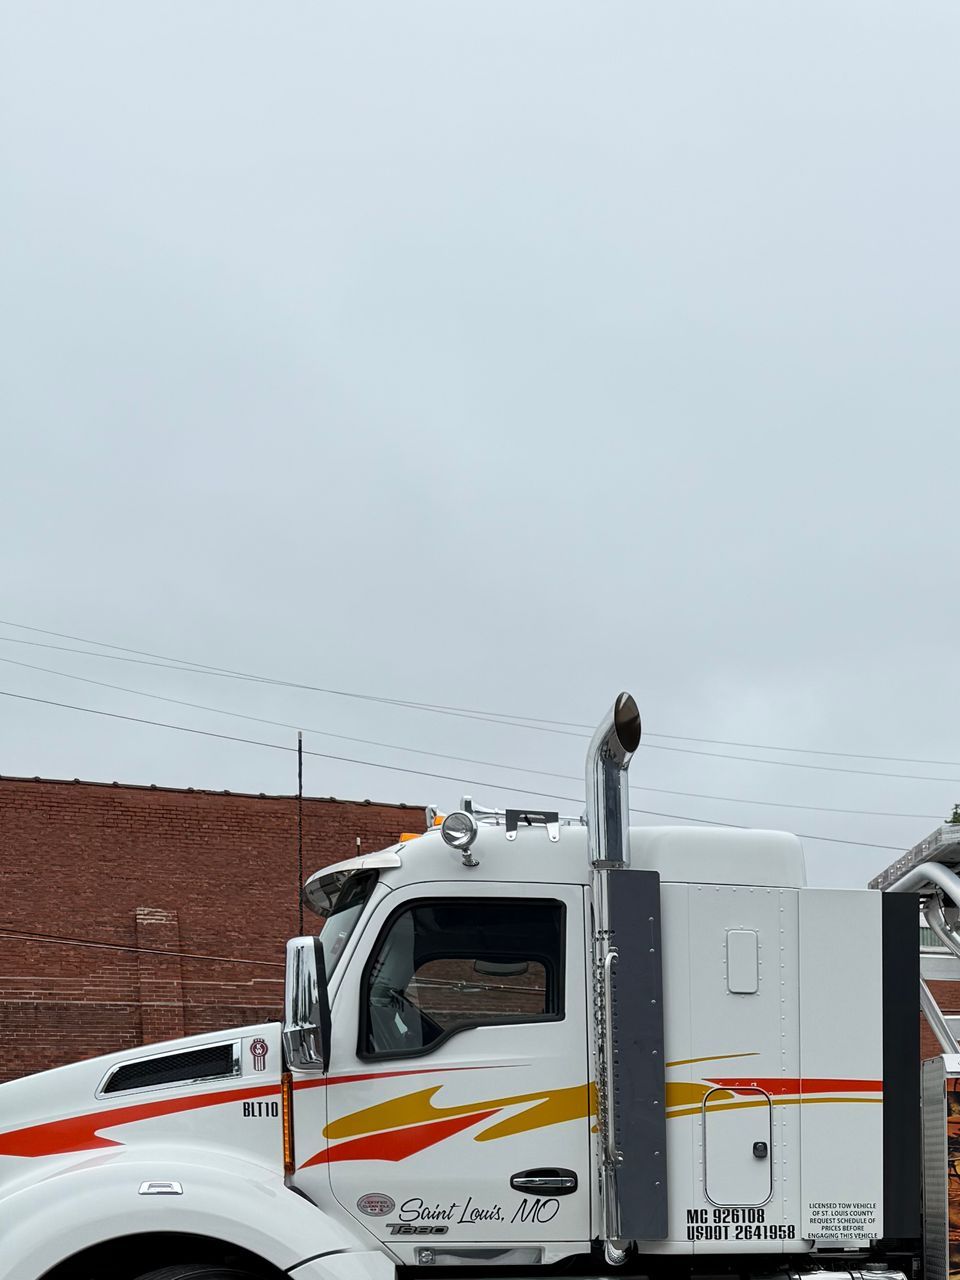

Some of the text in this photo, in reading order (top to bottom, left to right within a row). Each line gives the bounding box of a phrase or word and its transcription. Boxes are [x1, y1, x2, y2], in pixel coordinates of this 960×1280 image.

[243, 1101, 279, 1117] BLT10
[399, 1197, 461, 1222] Saint
[510, 1198, 560, 1223] MO
[686, 1208, 765, 1224] MC 926108
[686, 1225, 796, 1240] USDOT 2641958
